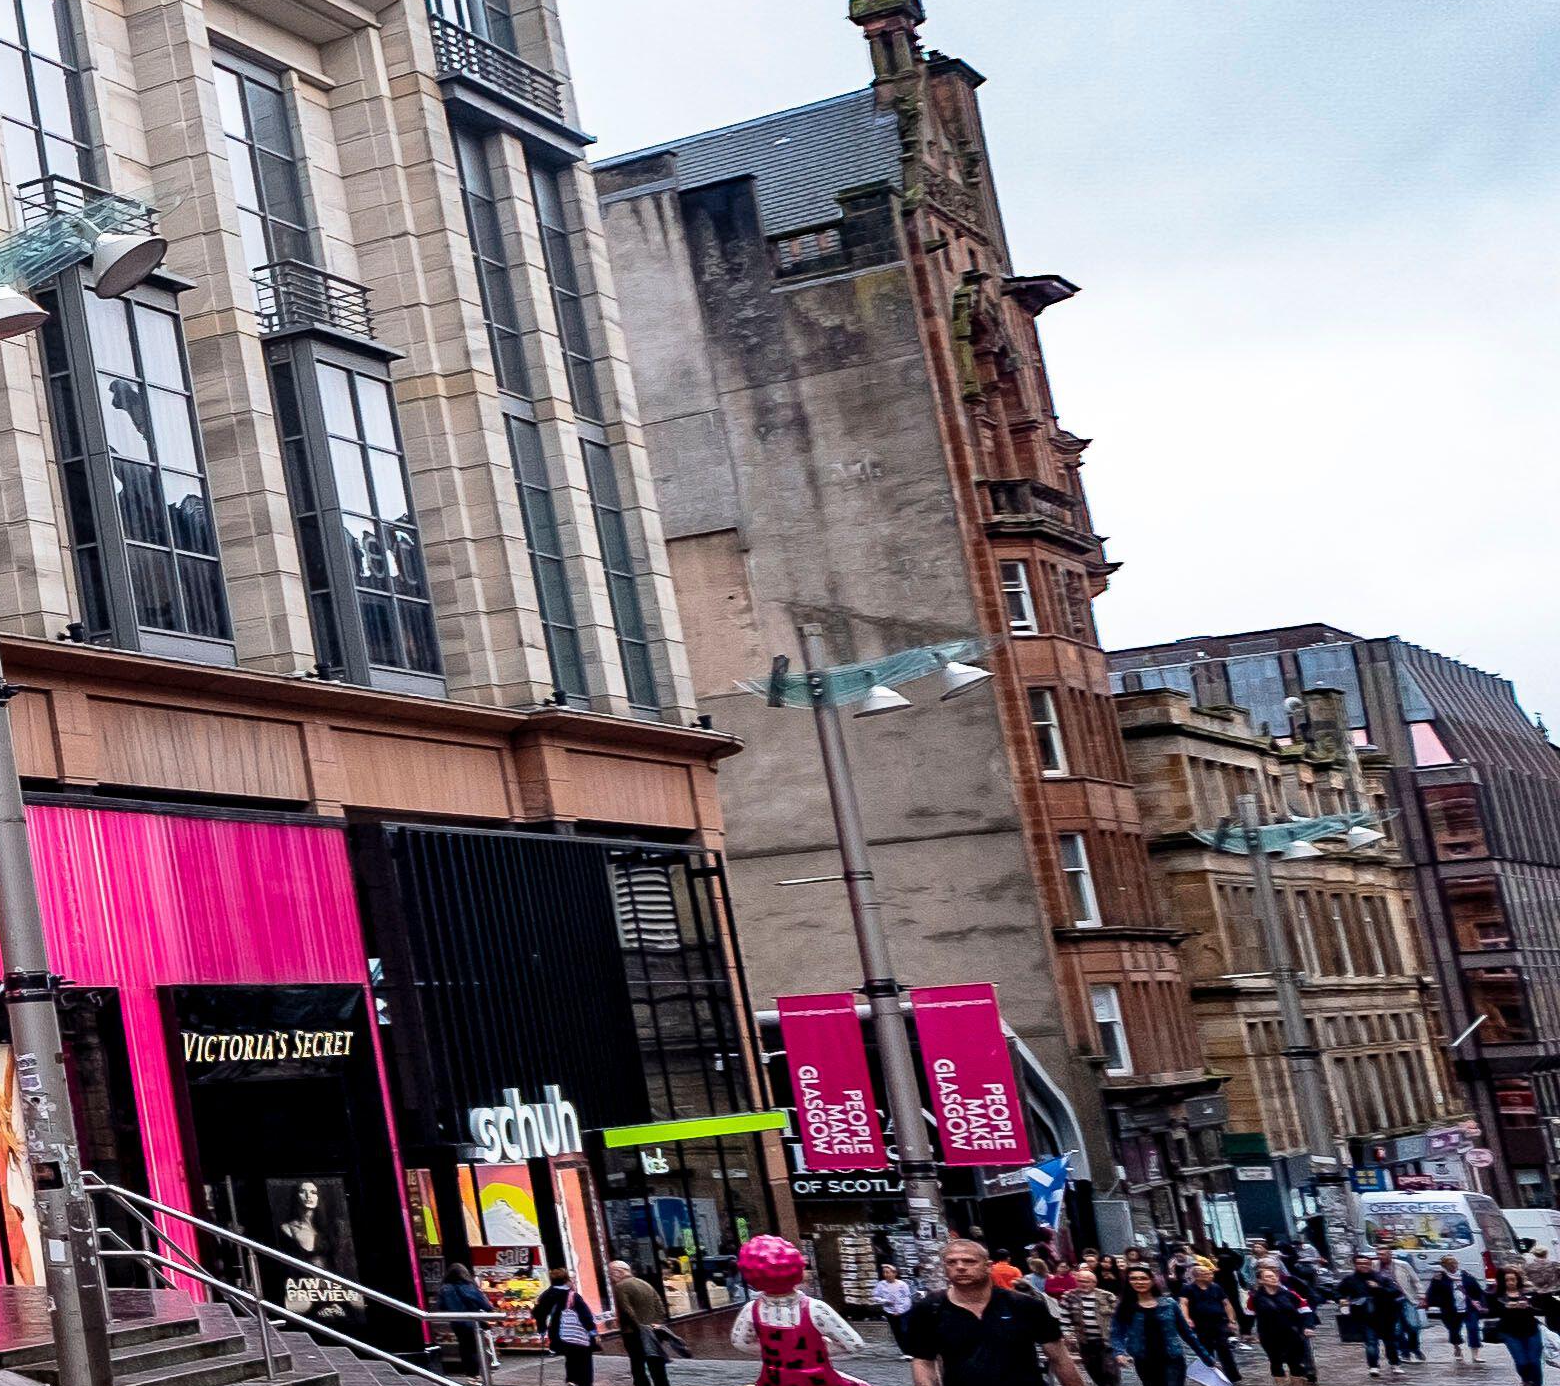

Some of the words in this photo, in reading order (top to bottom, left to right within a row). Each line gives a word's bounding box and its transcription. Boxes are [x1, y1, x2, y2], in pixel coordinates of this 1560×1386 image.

[181, 1030, 289, 1062] VICTORIA'S
[291, 1029, 354, 1059] SECRET
[469, 1084, 583, 1163] schuh
[798, 1065, 834, 1156] GLASGOW
[824, 1103, 855, 1155] MAKE
[842, 1089, 875, 1154] PEOPLE
[933, 1058, 973, 1151] GLASGOW
[963, 1098, 994, 1151] MAKE
[982, 1083, 1017, 1151] PEOPLE
[794, 1180, 822, 1194] OF
[828, 1179, 907, 1194] SCOTLA
[495, 1247, 529, 1266] sale
[286, 1289, 359, 1302] PREVIEW
